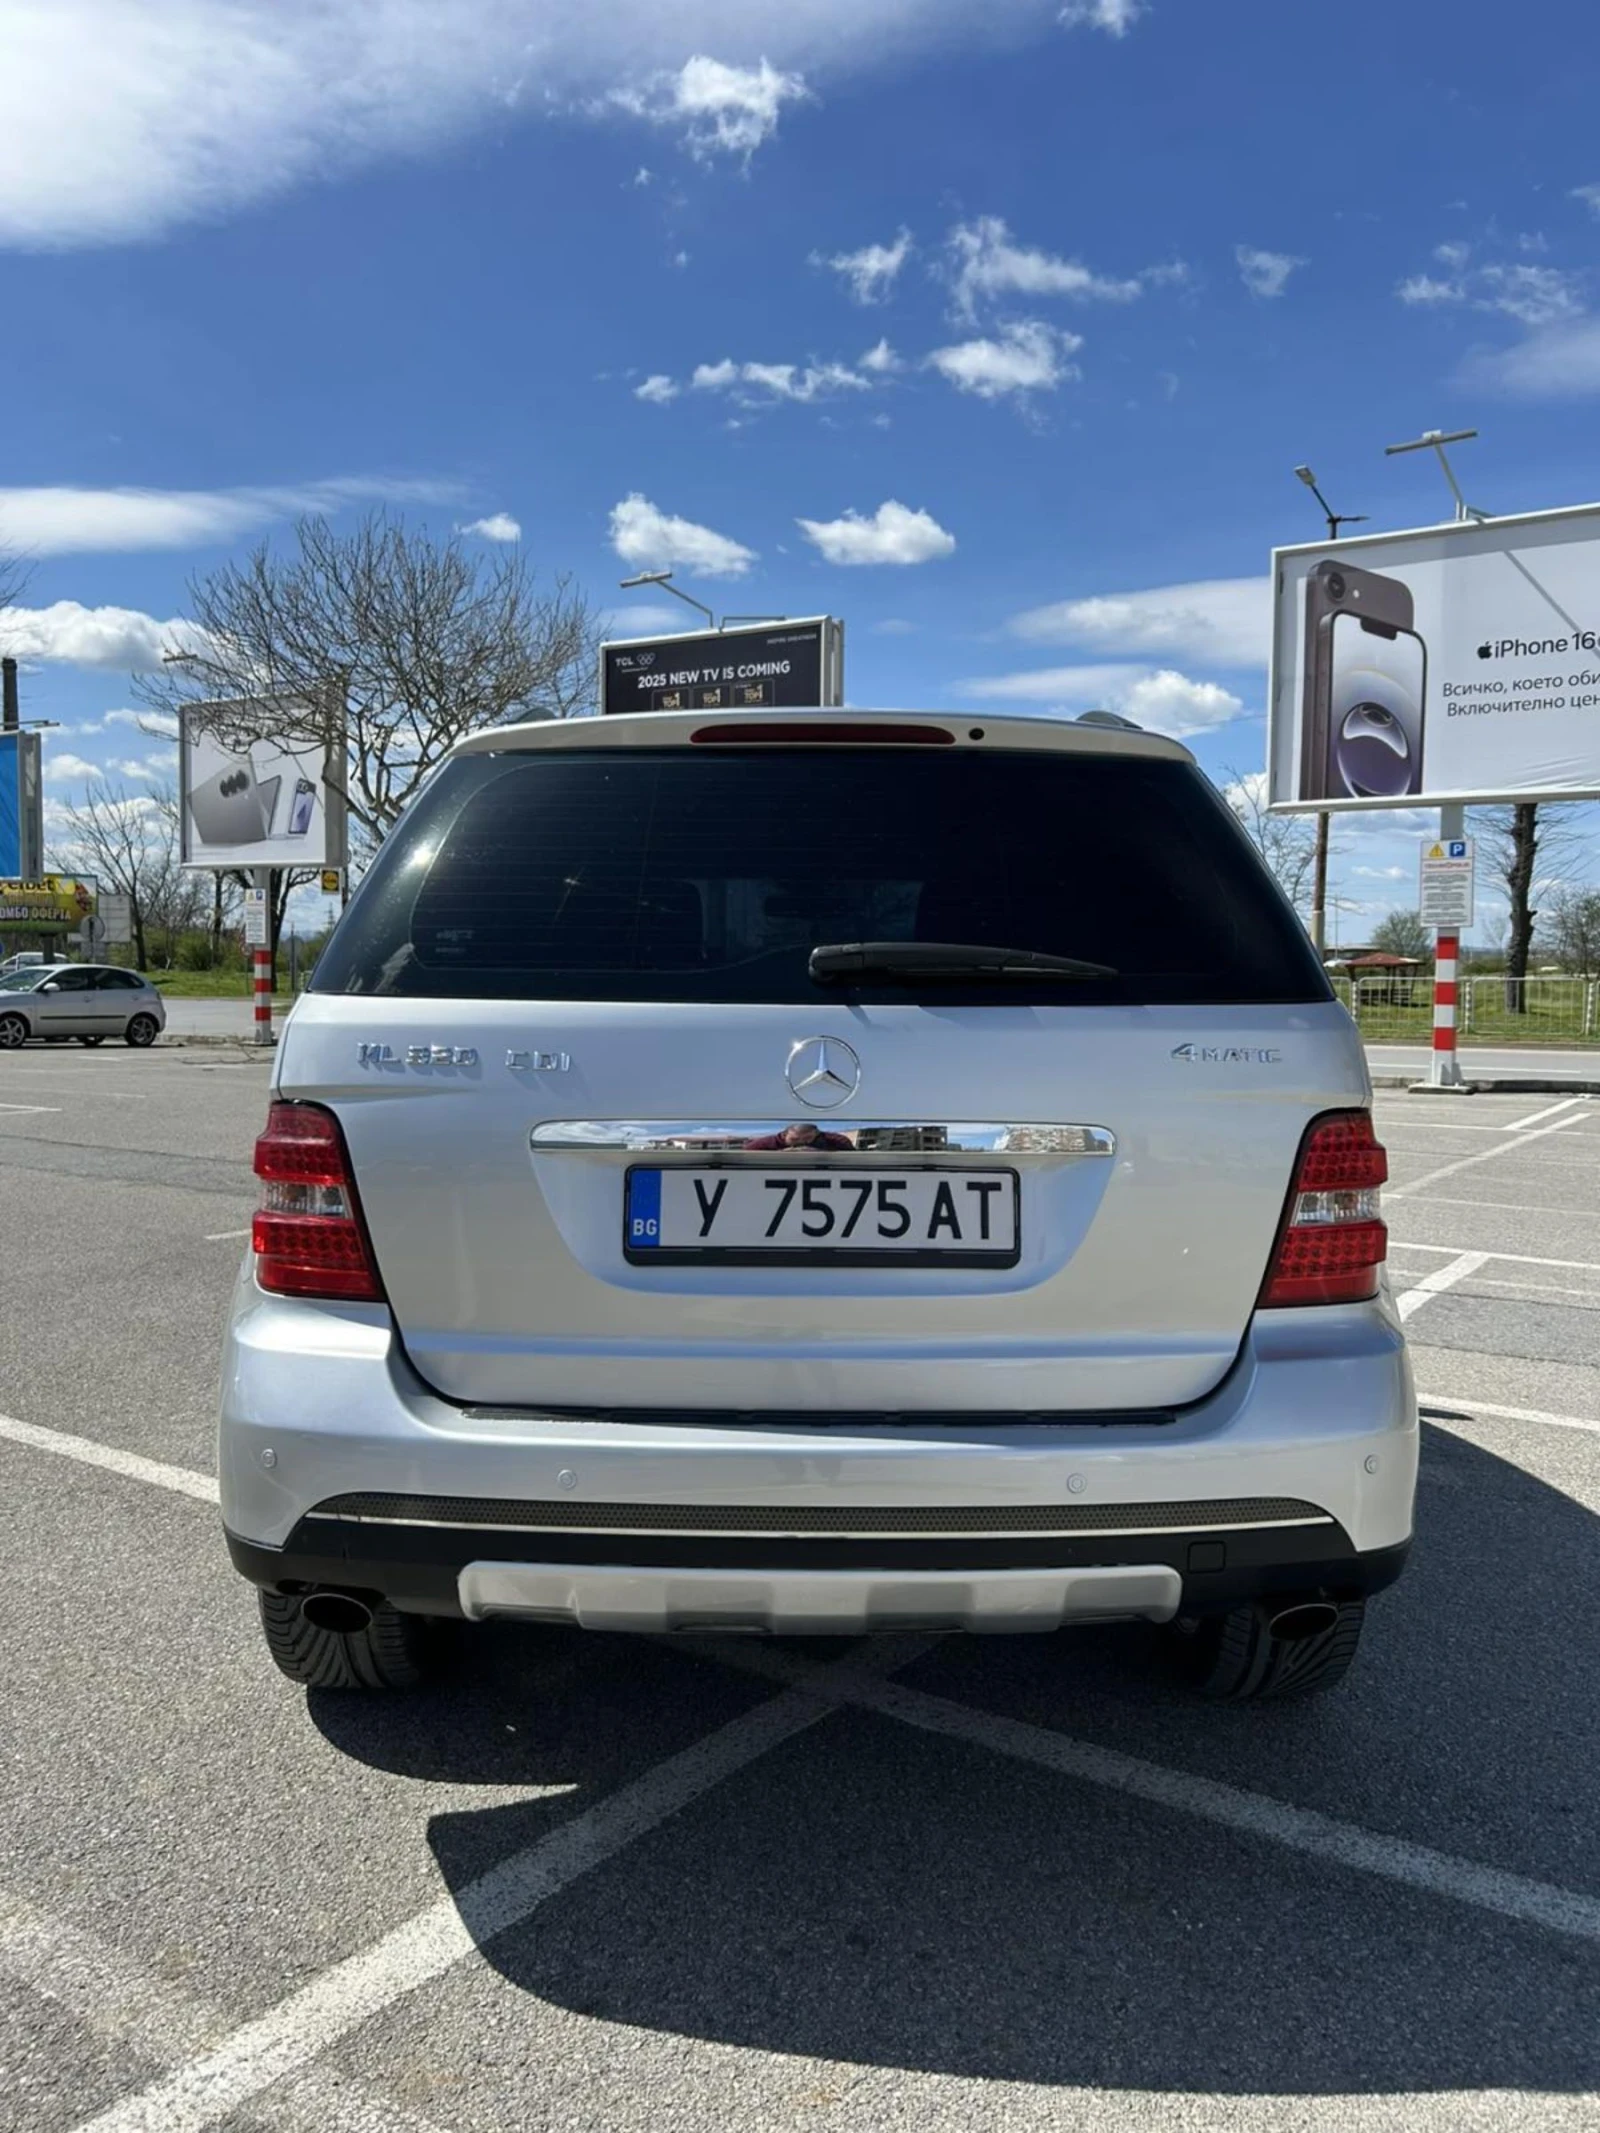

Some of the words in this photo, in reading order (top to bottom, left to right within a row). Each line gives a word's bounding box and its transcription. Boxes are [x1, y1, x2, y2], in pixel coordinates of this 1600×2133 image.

[1495, 638, 1568, 659] iPhone
[1572, 631, 1600, 651] 16
[615, 656, 634, 667] TCL
[637, 673, 667, 689] 2025
[669, 669, 700, 685] NEW
[702, 667, 720, 682] TV
[723, 664, 735, 679] IS
[737, 660, 791, 678] COMING
[1443, 680, 1508, 698] Всичко,
[1512, 675, 1564, 691] което
[1447, 696, 1566, 717] Включително
[505, 1049, 571, 1071] CDI
[1171, 1043, 1282, 1063] 4MATIC
[764, 1179, 911, 1238] 7575
[927, 1181, 1002, 1239] AT
[633, 1219, 658, 1236] BG
